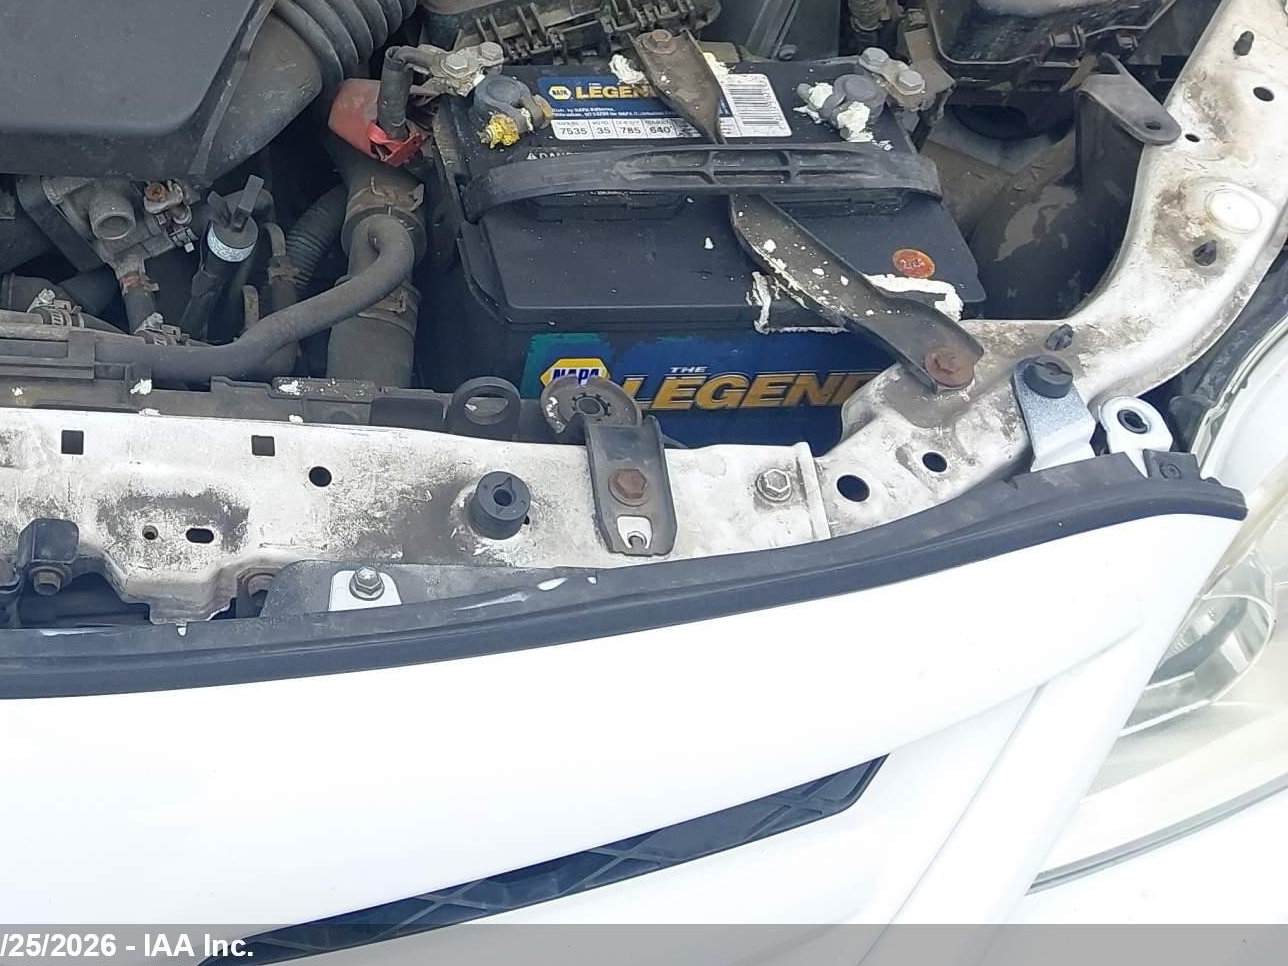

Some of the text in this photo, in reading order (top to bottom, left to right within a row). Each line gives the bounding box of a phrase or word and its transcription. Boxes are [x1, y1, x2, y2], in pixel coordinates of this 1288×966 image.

[560, 126, 588, 135] 7535
[597, 126, 611, 135] 35
[621, 126, 642, 135] 785
[670, 365, 710, 374] THE
